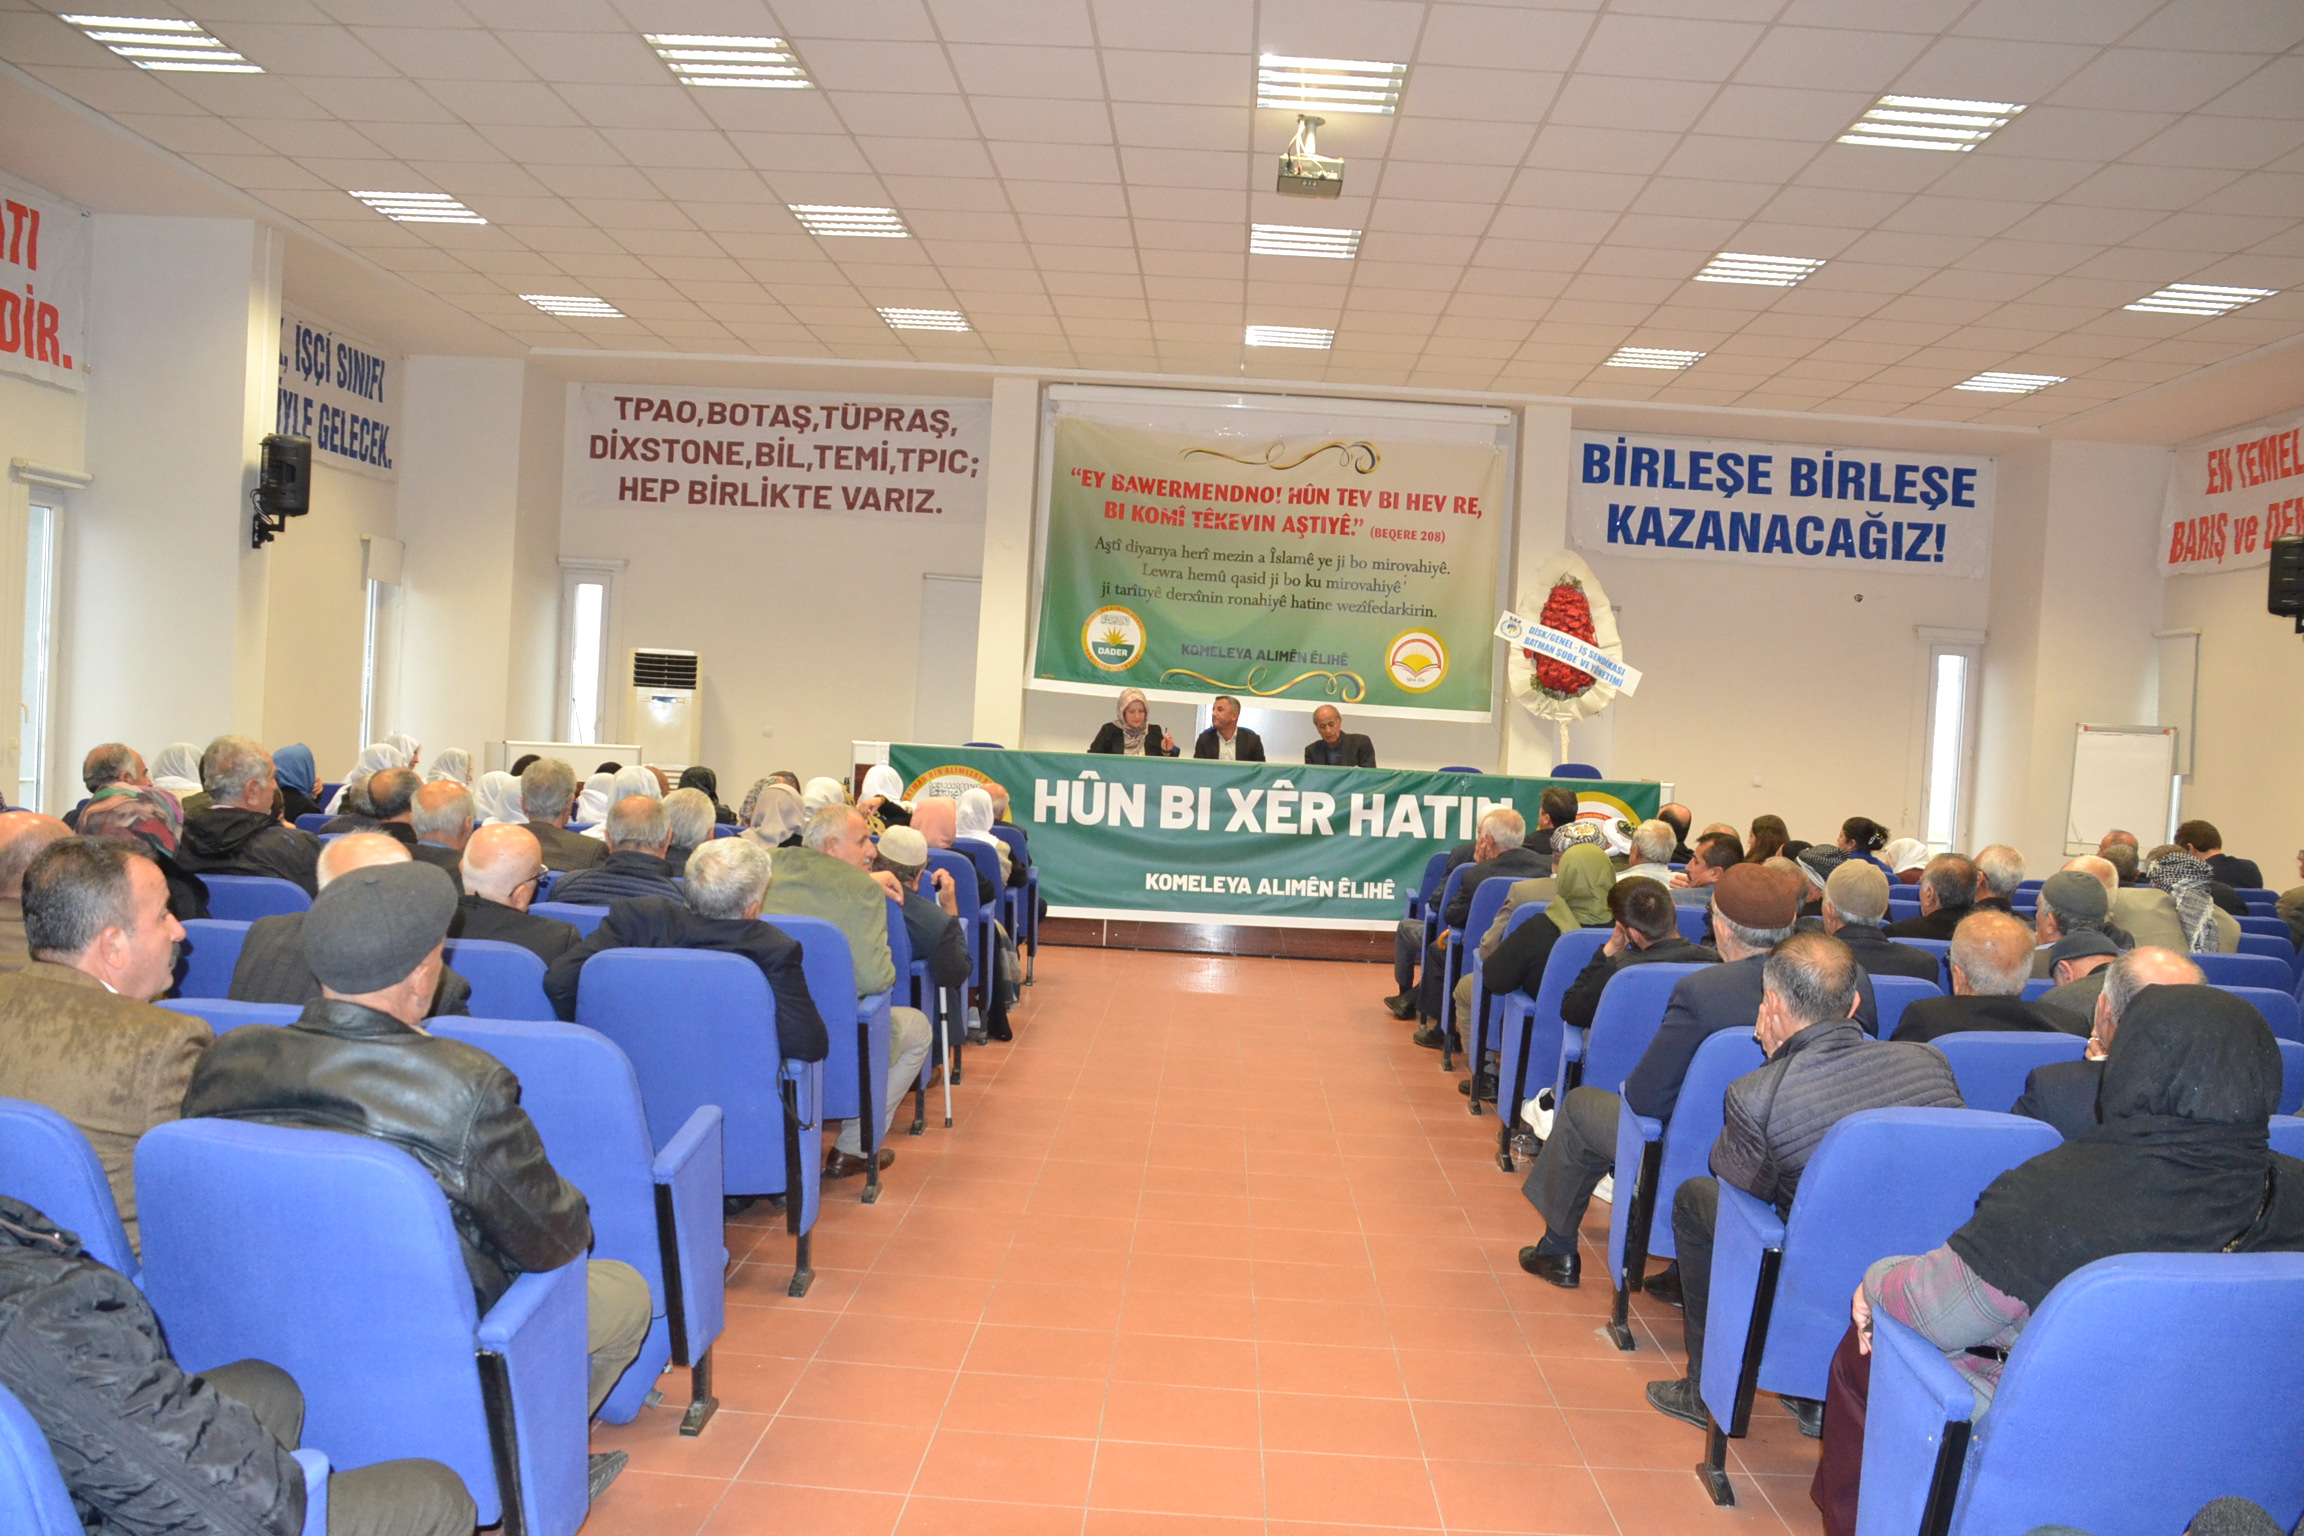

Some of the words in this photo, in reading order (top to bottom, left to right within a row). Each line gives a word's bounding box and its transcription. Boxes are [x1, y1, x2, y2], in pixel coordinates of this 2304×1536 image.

[337, 343, 385, 403] SINIFI
[318, 403, 392, 469] GELECEK.
[1582, 437, 1773, 498] BİRLEŞE
[1790, 450, 1977, 511] BİRLEŞE
[2205, 447, 2233, 495] EN
[2236, 427, 2304, 488] TEMEL
[618, 476, 680, 502] HEP
[687, 474, 833, 510] BİRLİKTE
[841, 486, 943, 514] VARIZ.
[1111, 474, 1282, 504] BAWERMENDNO!
[1288, 483, 1330, 505] HÛN
[1336, 488, 1372, 508] TEV
[1378, 490, 1399, 509] BI
[1406, 493, 1447, 513] HEV
[1453, 496, 1483, 519] RE,
[1104, 501, 1125, 520] BI
[1131, 505, 1186, 527] KOMÎ
[1192, 507, 1276, 533] TÊKEVIN
[1370, 526, 1417, 543] (BEQERE
[1420, 530, 1446, 544] 208)
[1607, 503, 1946, 563] KAZANACAĞIZ!
[2168, 512, 2228, 564] BARIŞ
[2234, 515, 2259, 554] ve
[1094, 536, 1122, 554] Aştî
[1181, 545, 1210, 560] herî
[1212, 550, 1254, 563] mezin
[1258, 555, 1265, 564] a
[1269, 547, 1315, 565] Îslamê
[1318, 556, 1333, 571] ye
[1335, 555, 1345, 572] ji
[1350, 554, 1367, 569] bo
[1371, 558, 1450, 579] mirovahiyê.
[1142, 563, 1183, 580] Lewra
[1188, 567, 1226, 582] hemû
[1230, 571, 1266, 588] qasid
[1268, 573, 1279, 589] ji
[1284, 572, 1301, 587] bo
[1305, 574, 1321, 588] ku
[1100, 582, 1110, 598] ji
[1166, 587, 1224, 604] derxînin
[1227, 592, 1286, 612] ronahiyê
[1290, 595, 1333, 611] hatine
[1336, 600, 1437, 618] wezîfedarkirin.
[1098, 647, 1128, 656] DADER
[1181, 643, 1252, 660] KOMELEYA
[1256, 649, 1307, 663] ALIMÊN
[1310, 650, 1348, 666] ÊLIHÊ
[1524, 637, 1555, 655] BATMAN
[1555, 648, 1578, 664] ŞUBE
[1580, 659, 1591, 668] VE
[1528, 626, 1574, 649] DİSK/GENEL
[1033, 770, 1146, 828] HÛN
[1160, 784, 1212, 831] BI
[1224, 779, 1336, 835] XÊR
[1145, 873, 1252, 894] KOMELEYA
[1256, 876, 1333, 898] ALIMÊN
[1338, 877, 1395, 900] ÊLIHÊ
